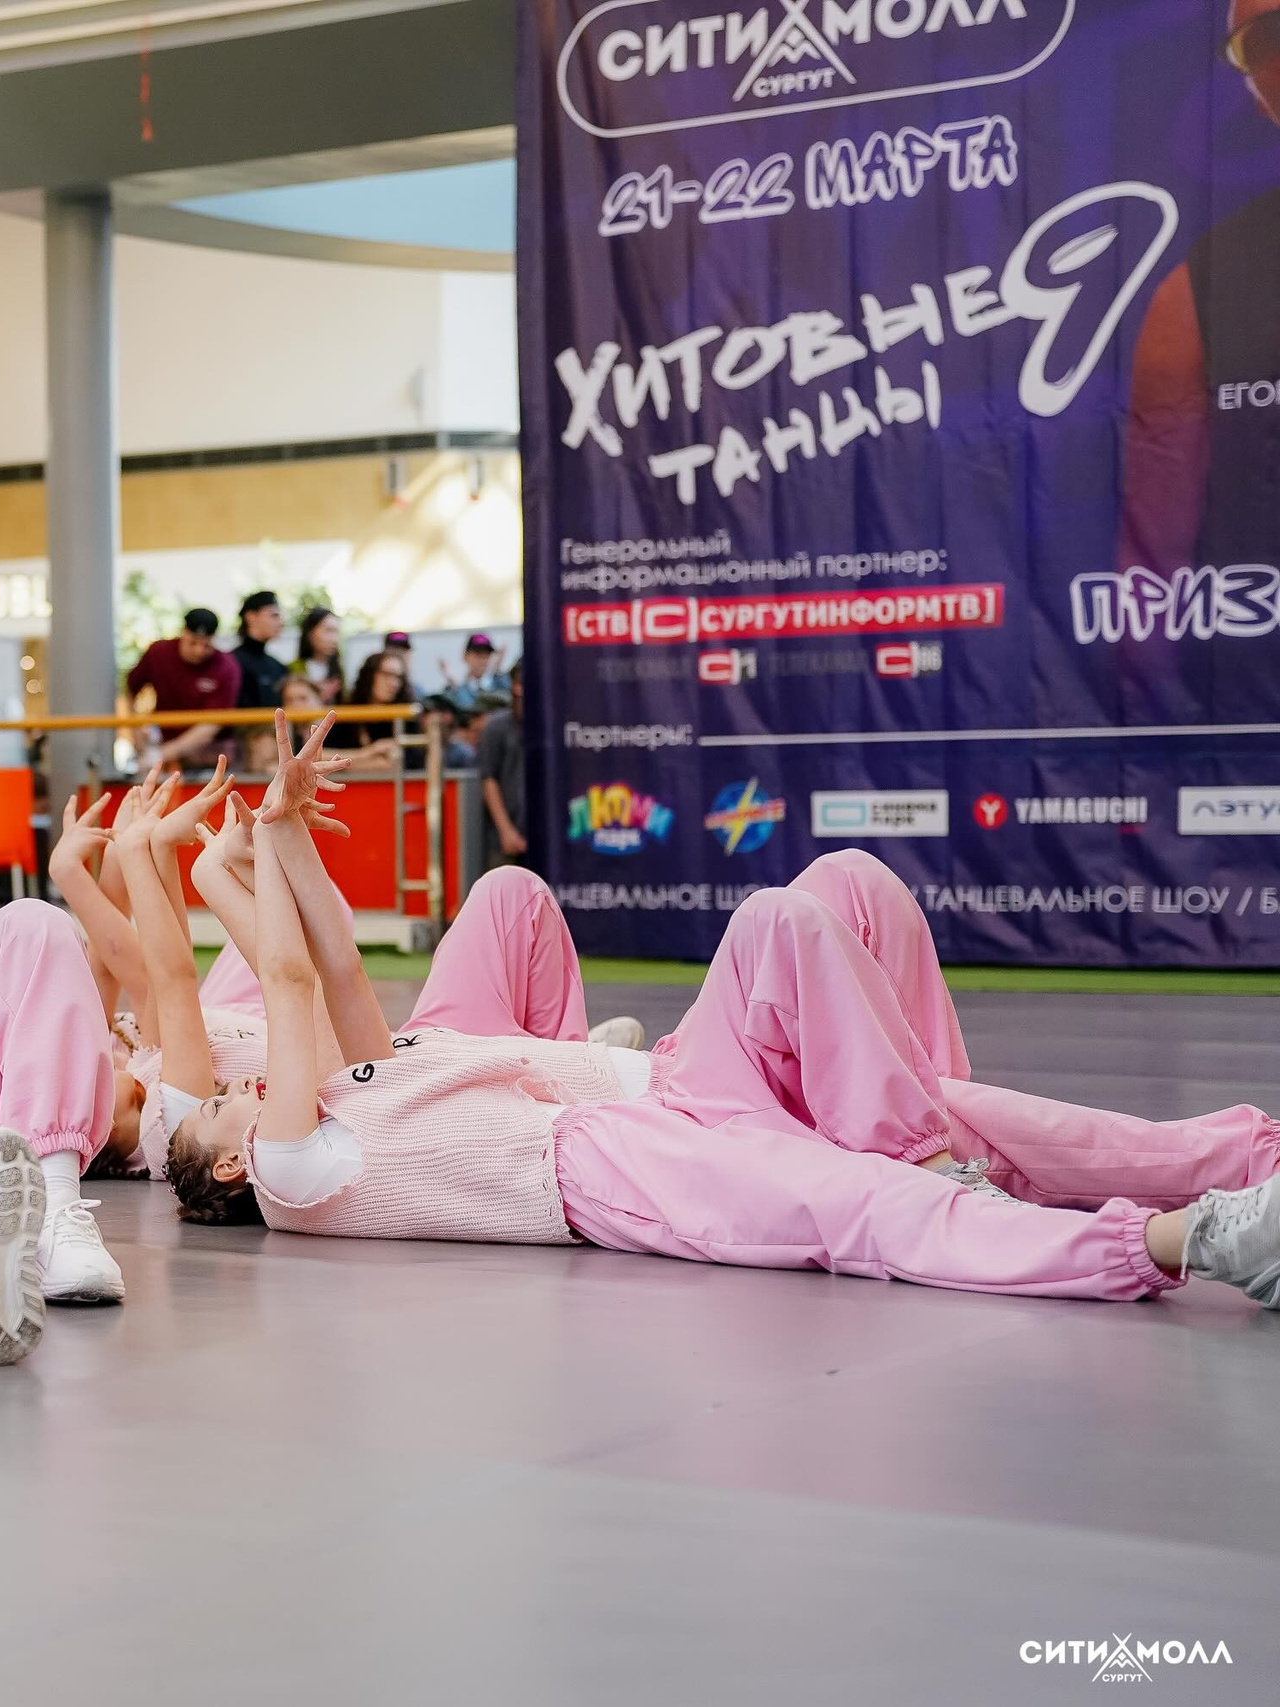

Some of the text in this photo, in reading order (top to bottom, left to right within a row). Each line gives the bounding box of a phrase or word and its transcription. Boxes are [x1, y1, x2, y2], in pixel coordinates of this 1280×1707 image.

[751, 67, 838, 98] СУРГУТ
[597, 114, 1019, 237] 21-22 МАРТА
[555, 266, 1010, 457] ХИТОВЫЕ
[1218, 379, 1280, 411] ЕГО
[648, 360, 942, 505] ТАНЦЫ
[560, 528, 732, 565] Генеральный
[560, 548, 949, 595] информационный партнер:
[1070, 563, 1280, 645] ПРИЗ
[563, 721, 694, 752] Партнеры:
[1014, 796, 1149, 825] YAMAGUCHI
[1192, 799, 1280, 821] ЛЭТУ
[925, 884, 1145, 914] ТАНЦЕВАЛЬНОЕ
[1151, 885, 1231, 915] ШОУ
